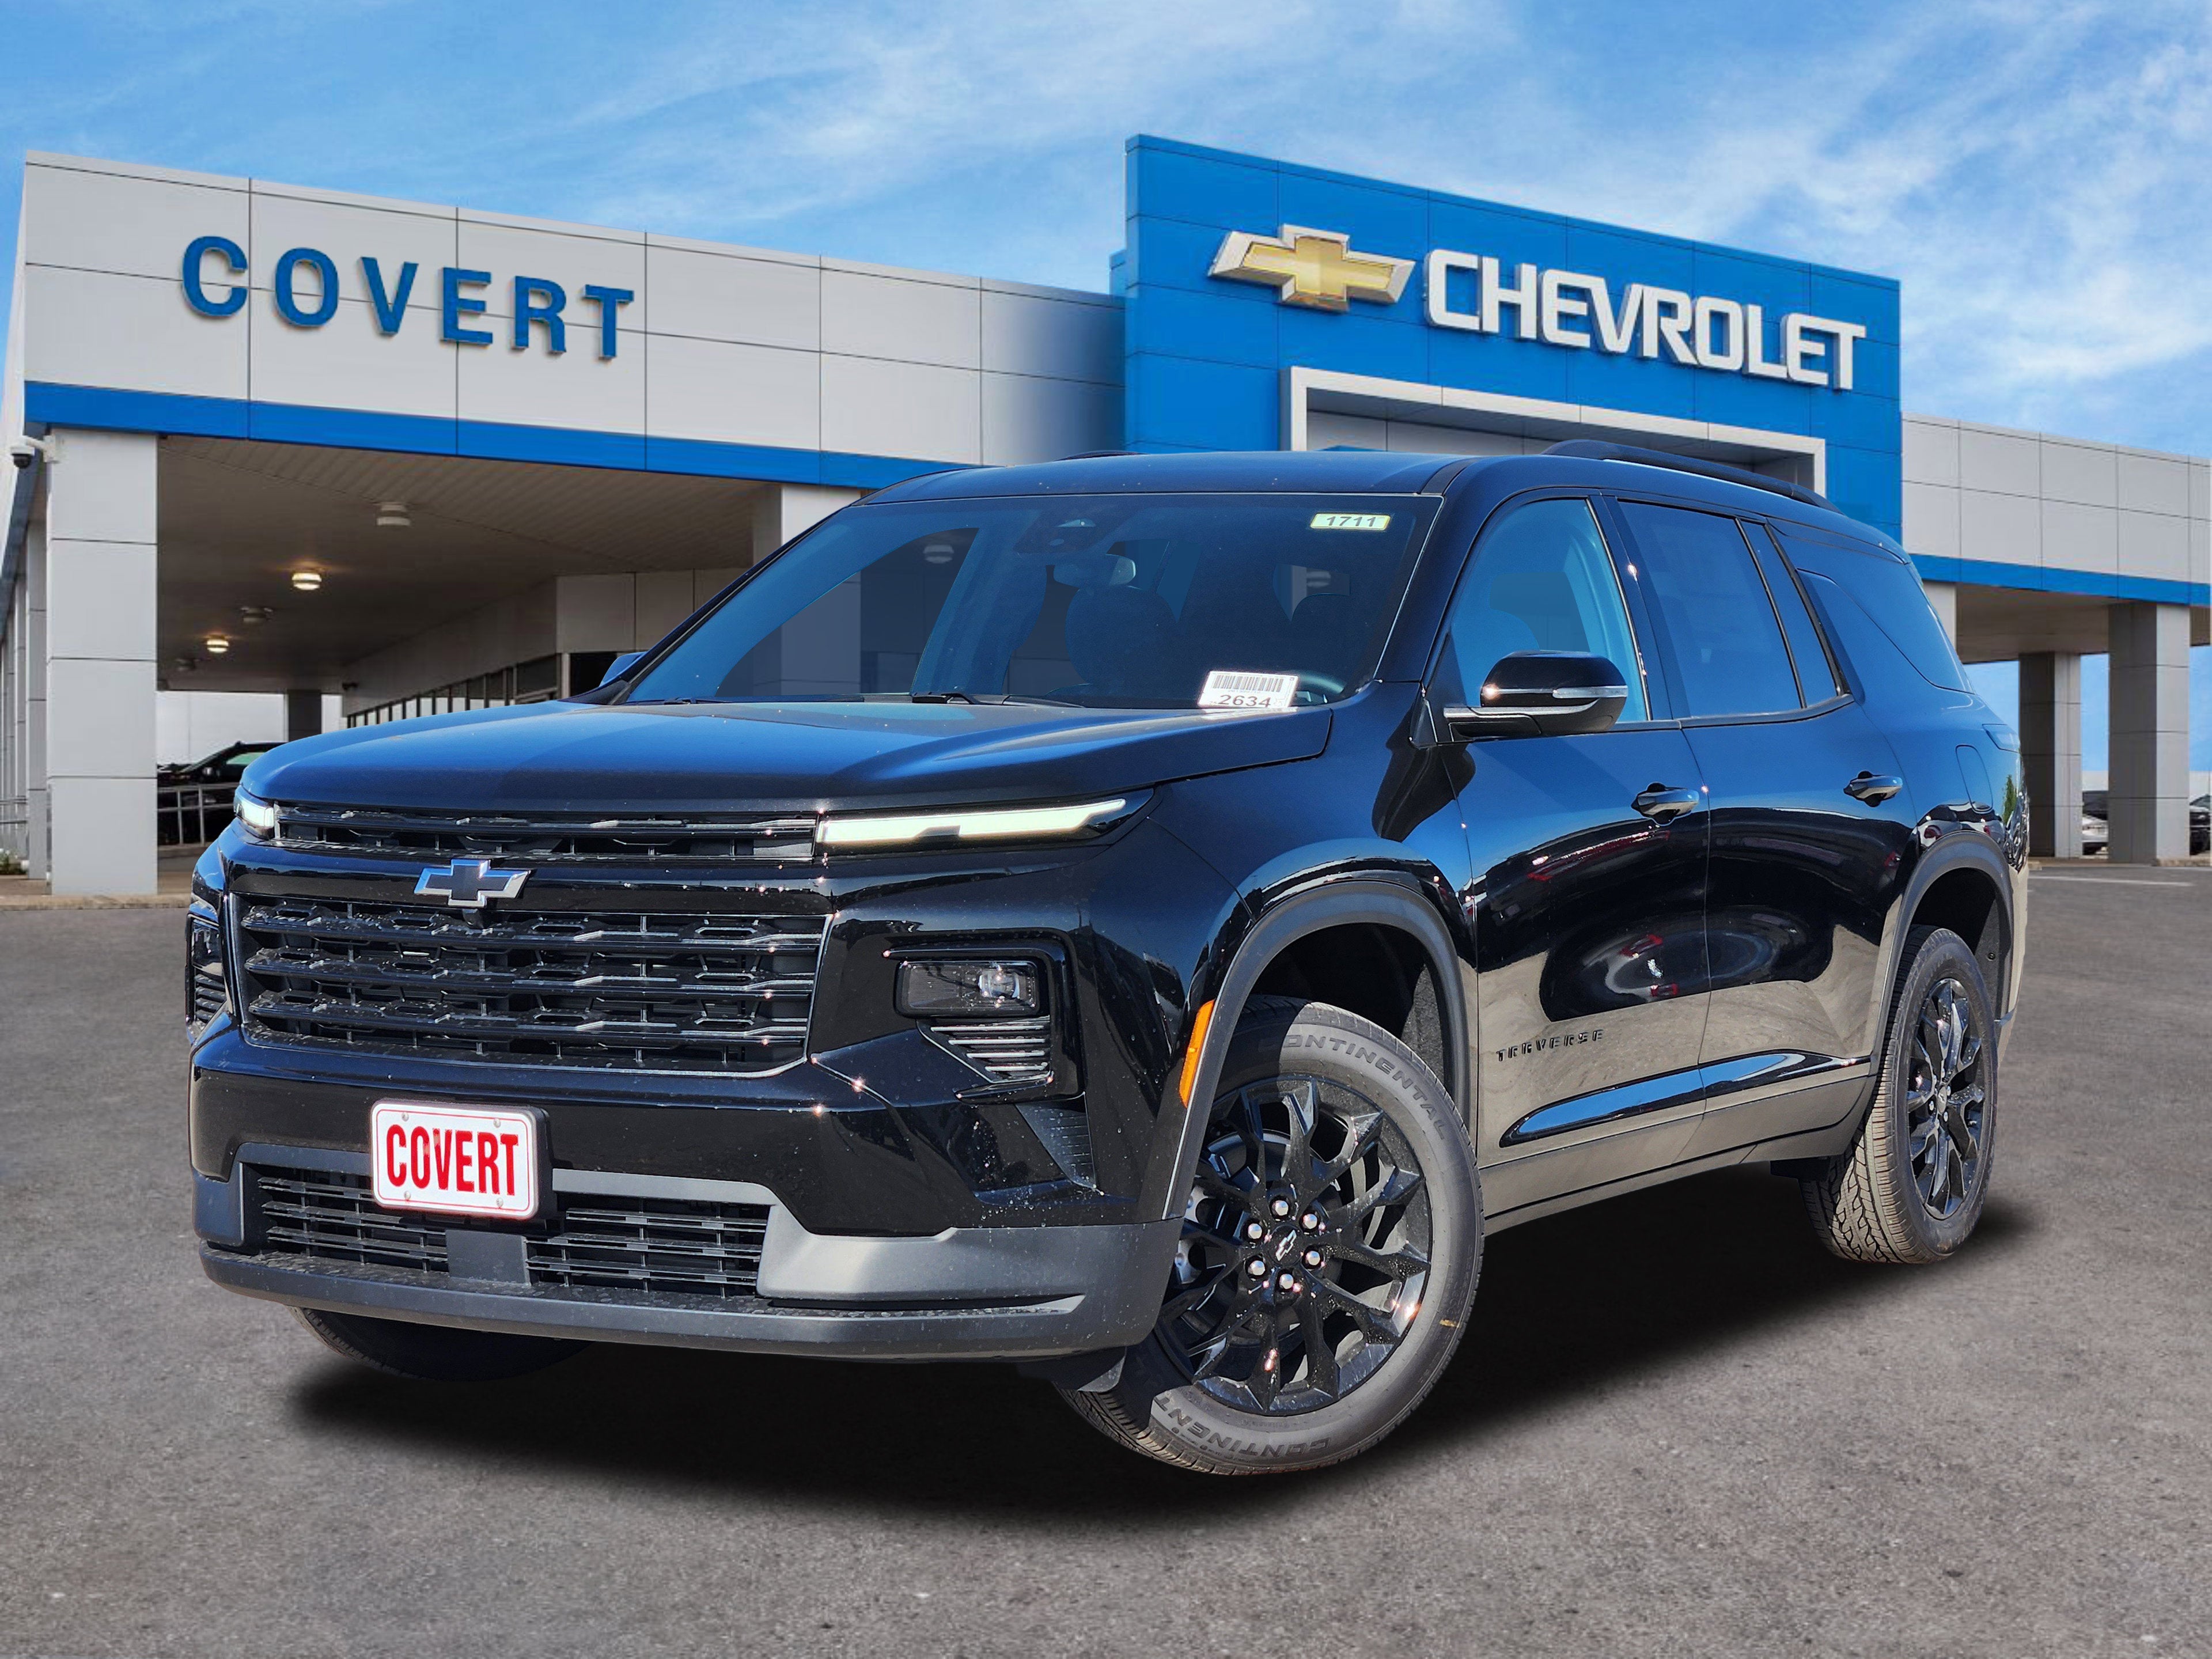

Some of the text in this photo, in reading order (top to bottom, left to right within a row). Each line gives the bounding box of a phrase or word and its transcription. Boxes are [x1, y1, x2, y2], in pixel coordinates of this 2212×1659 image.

[182, 236, 635, 359] COVERT
[1425, 248, 1866, 391] CHEVROLET
[1327, 516, 1376, 527] 1711
[1218, 695, 1271, 707] 2634
[1497, 1029, 1604, 1062] TRAVERSE
[1259, 1034, 1445, 1140] ONTINENTAL
[386, 1124, 519, 1196] COVERT
